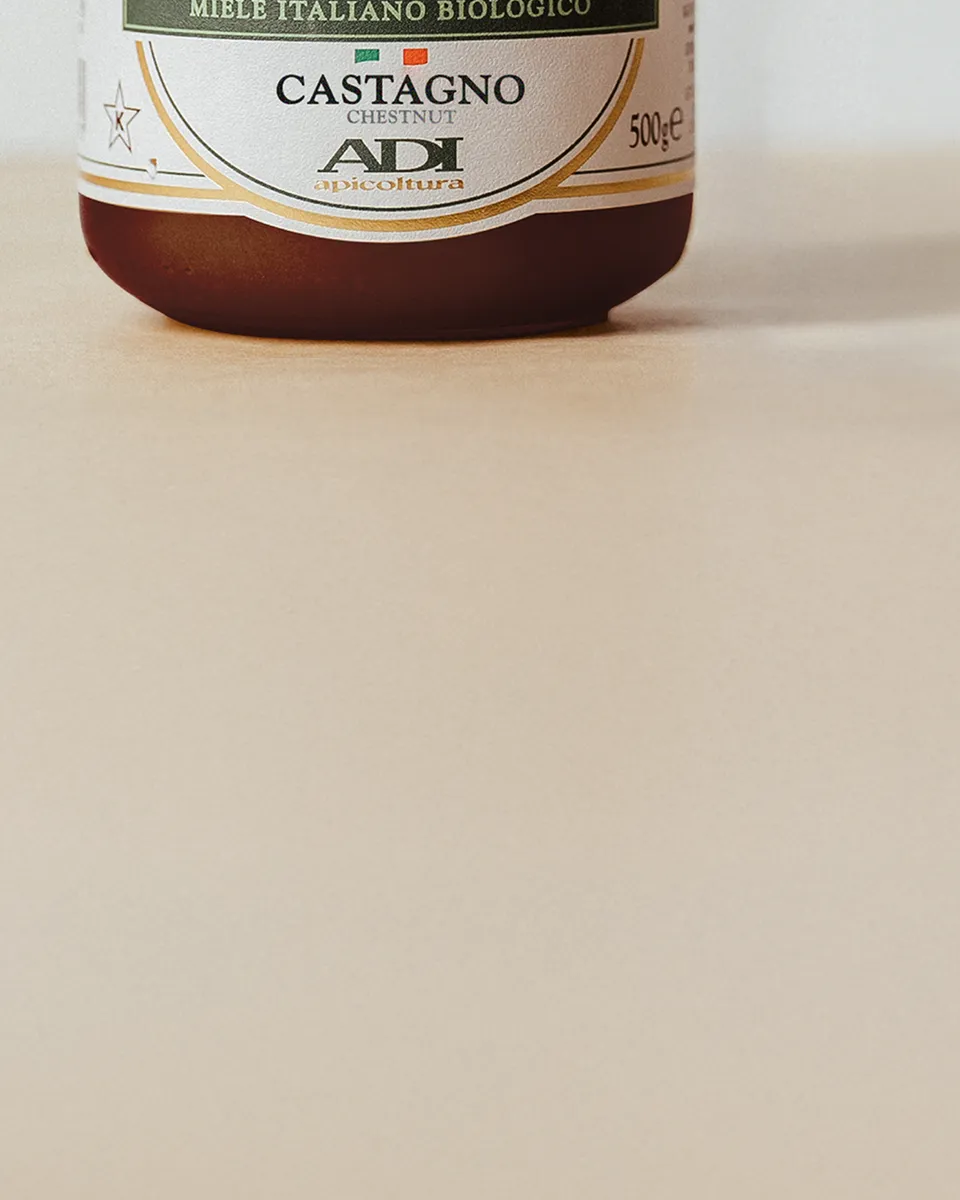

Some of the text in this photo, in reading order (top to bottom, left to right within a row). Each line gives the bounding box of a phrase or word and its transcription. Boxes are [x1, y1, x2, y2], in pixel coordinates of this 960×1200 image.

[278, 0, 426, 22] ITALIANO
[275, 73, 526, 106] CASTAGNO
[346, 109, 457, 125] CHESTNUT
[316, 136, 465, 174] ADI
[313, 176, 465, 194] apicoltura
